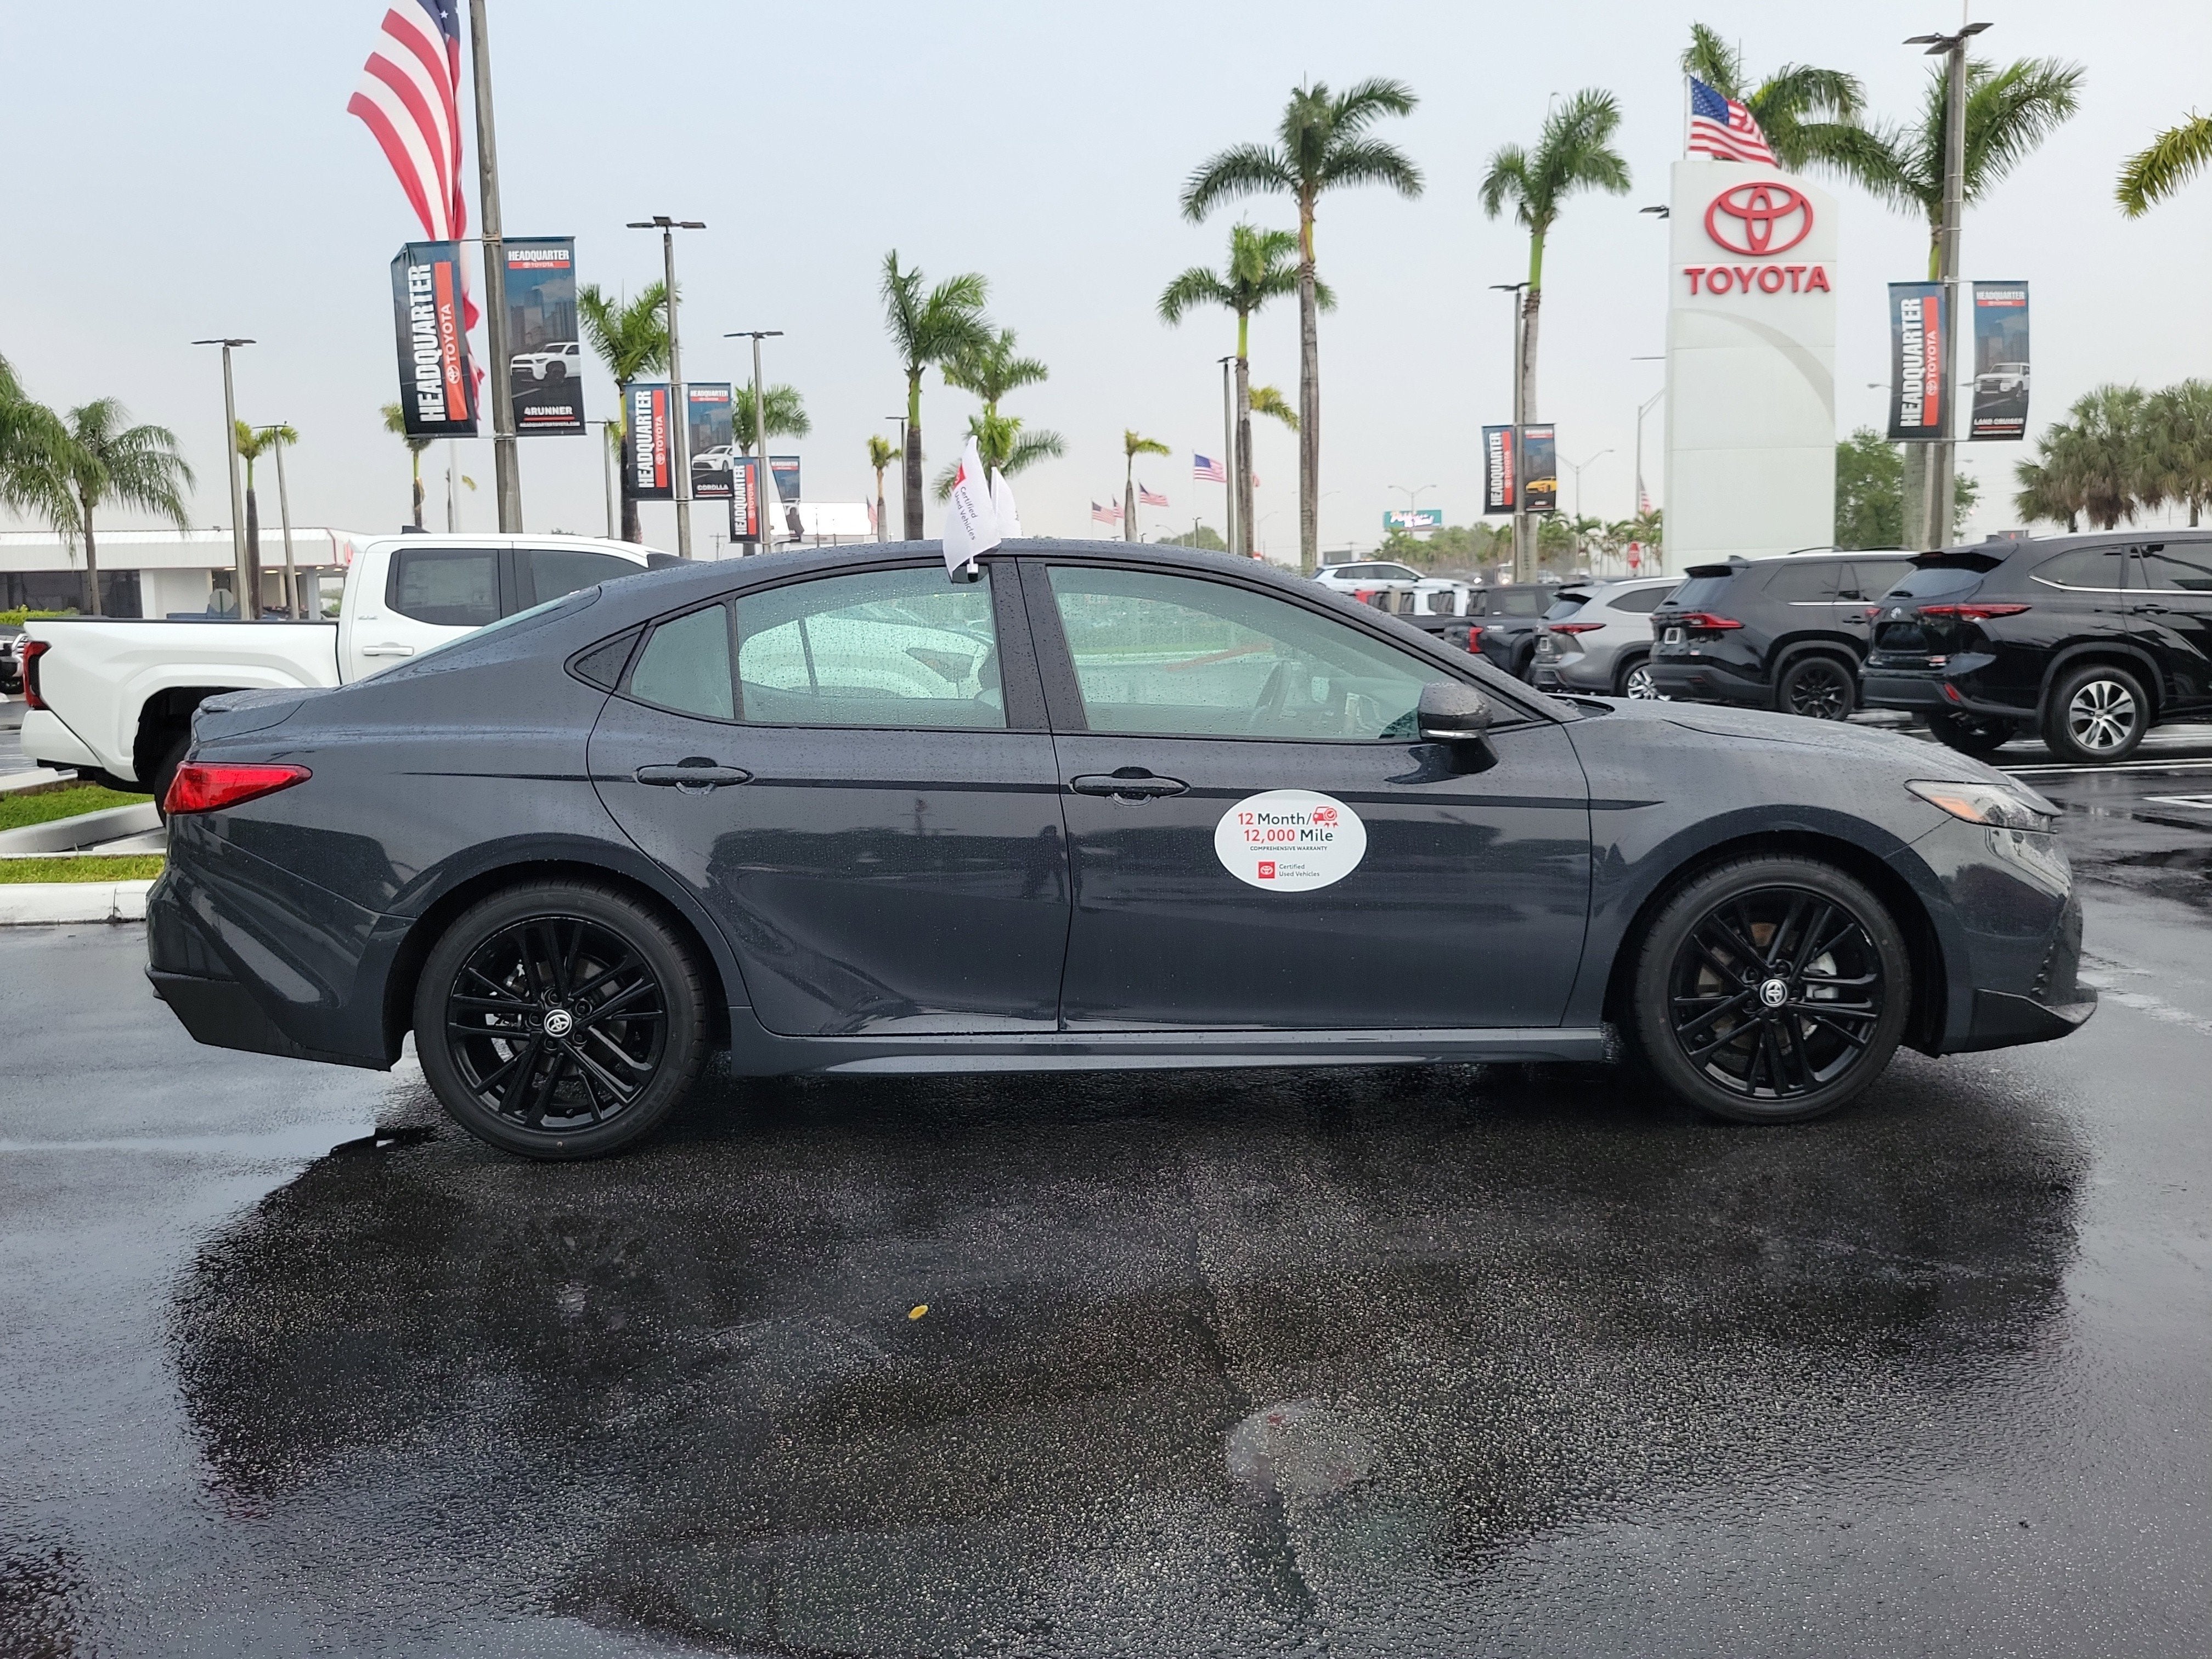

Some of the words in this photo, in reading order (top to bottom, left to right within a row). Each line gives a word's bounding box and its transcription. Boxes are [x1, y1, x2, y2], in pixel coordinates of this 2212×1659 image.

[508, 250, 569, 261] HEADQUARTER
[1684, 266, 1831, 295] TOYOTA
[408, 263, 446, 422] HEADQUARTER
[440, 303, 458, 364] TOYOTA
[1900, 298, 1925, 427] HEADQUARTER
[1926, 330, 1938, 379] TOYOTA
[524, 406, 573, 415] 4RUNNER
[635, 390, 655, 488] HEADQUARTER
[655, 415, 665, 453] TOYOTA
[733, 465, 748, 535] HEADQUARTER
[747, 483, 755, 510] TOYOTA
[961, 486, 978, 518] Certified
[960, 510, 976, 540] Vehicles
[1238, 812, 1253, 825] 12
[1257, 812, 1312, 825] Month/
[1244, 829, 1295, 844] 12,000
[1300, 829, 1334, 842] Mile
